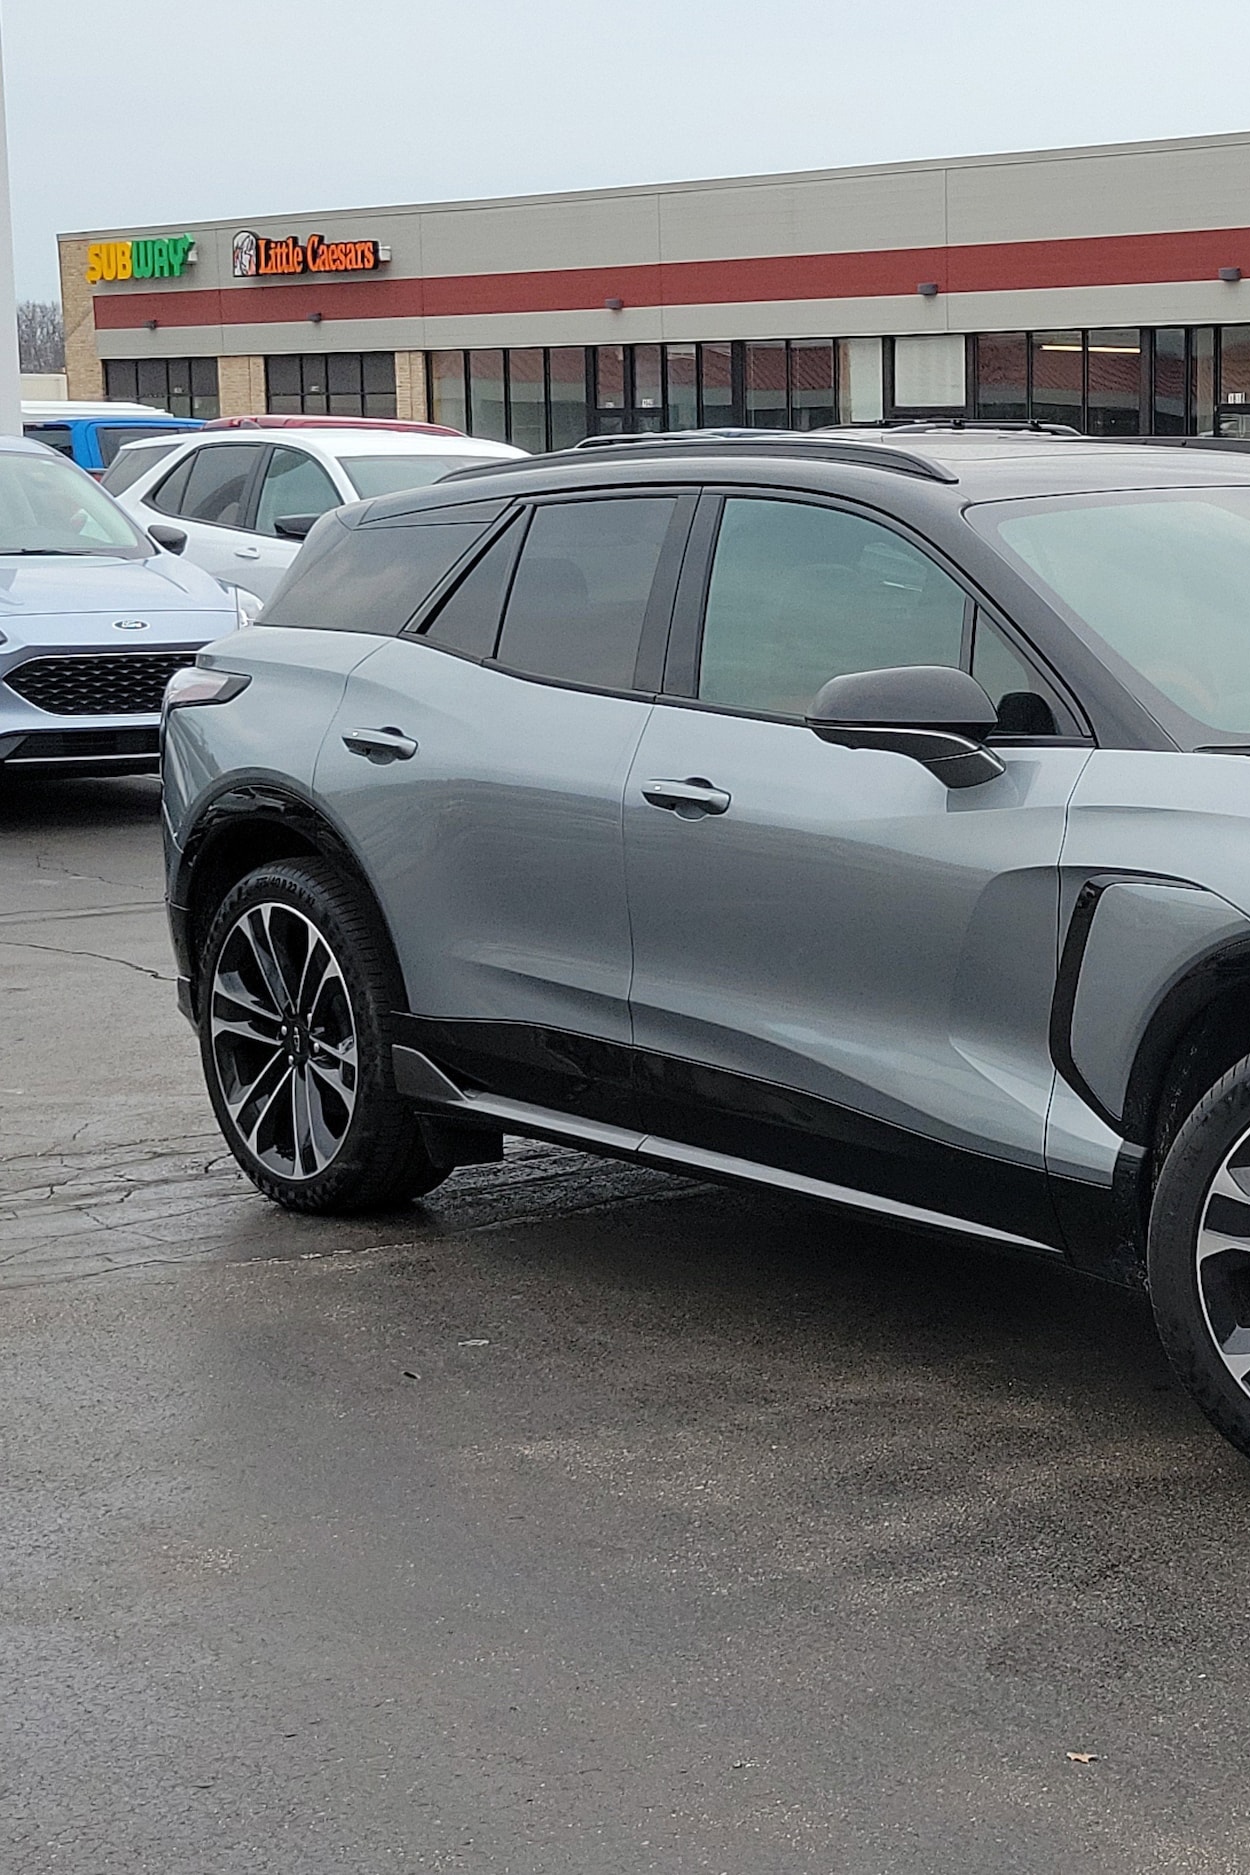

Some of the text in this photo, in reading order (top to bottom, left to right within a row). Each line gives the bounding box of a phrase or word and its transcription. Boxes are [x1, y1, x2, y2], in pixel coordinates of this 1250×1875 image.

[86, 233, 195, 284] SUBWAY
[258, 234, 375, 275] Little Caesars
